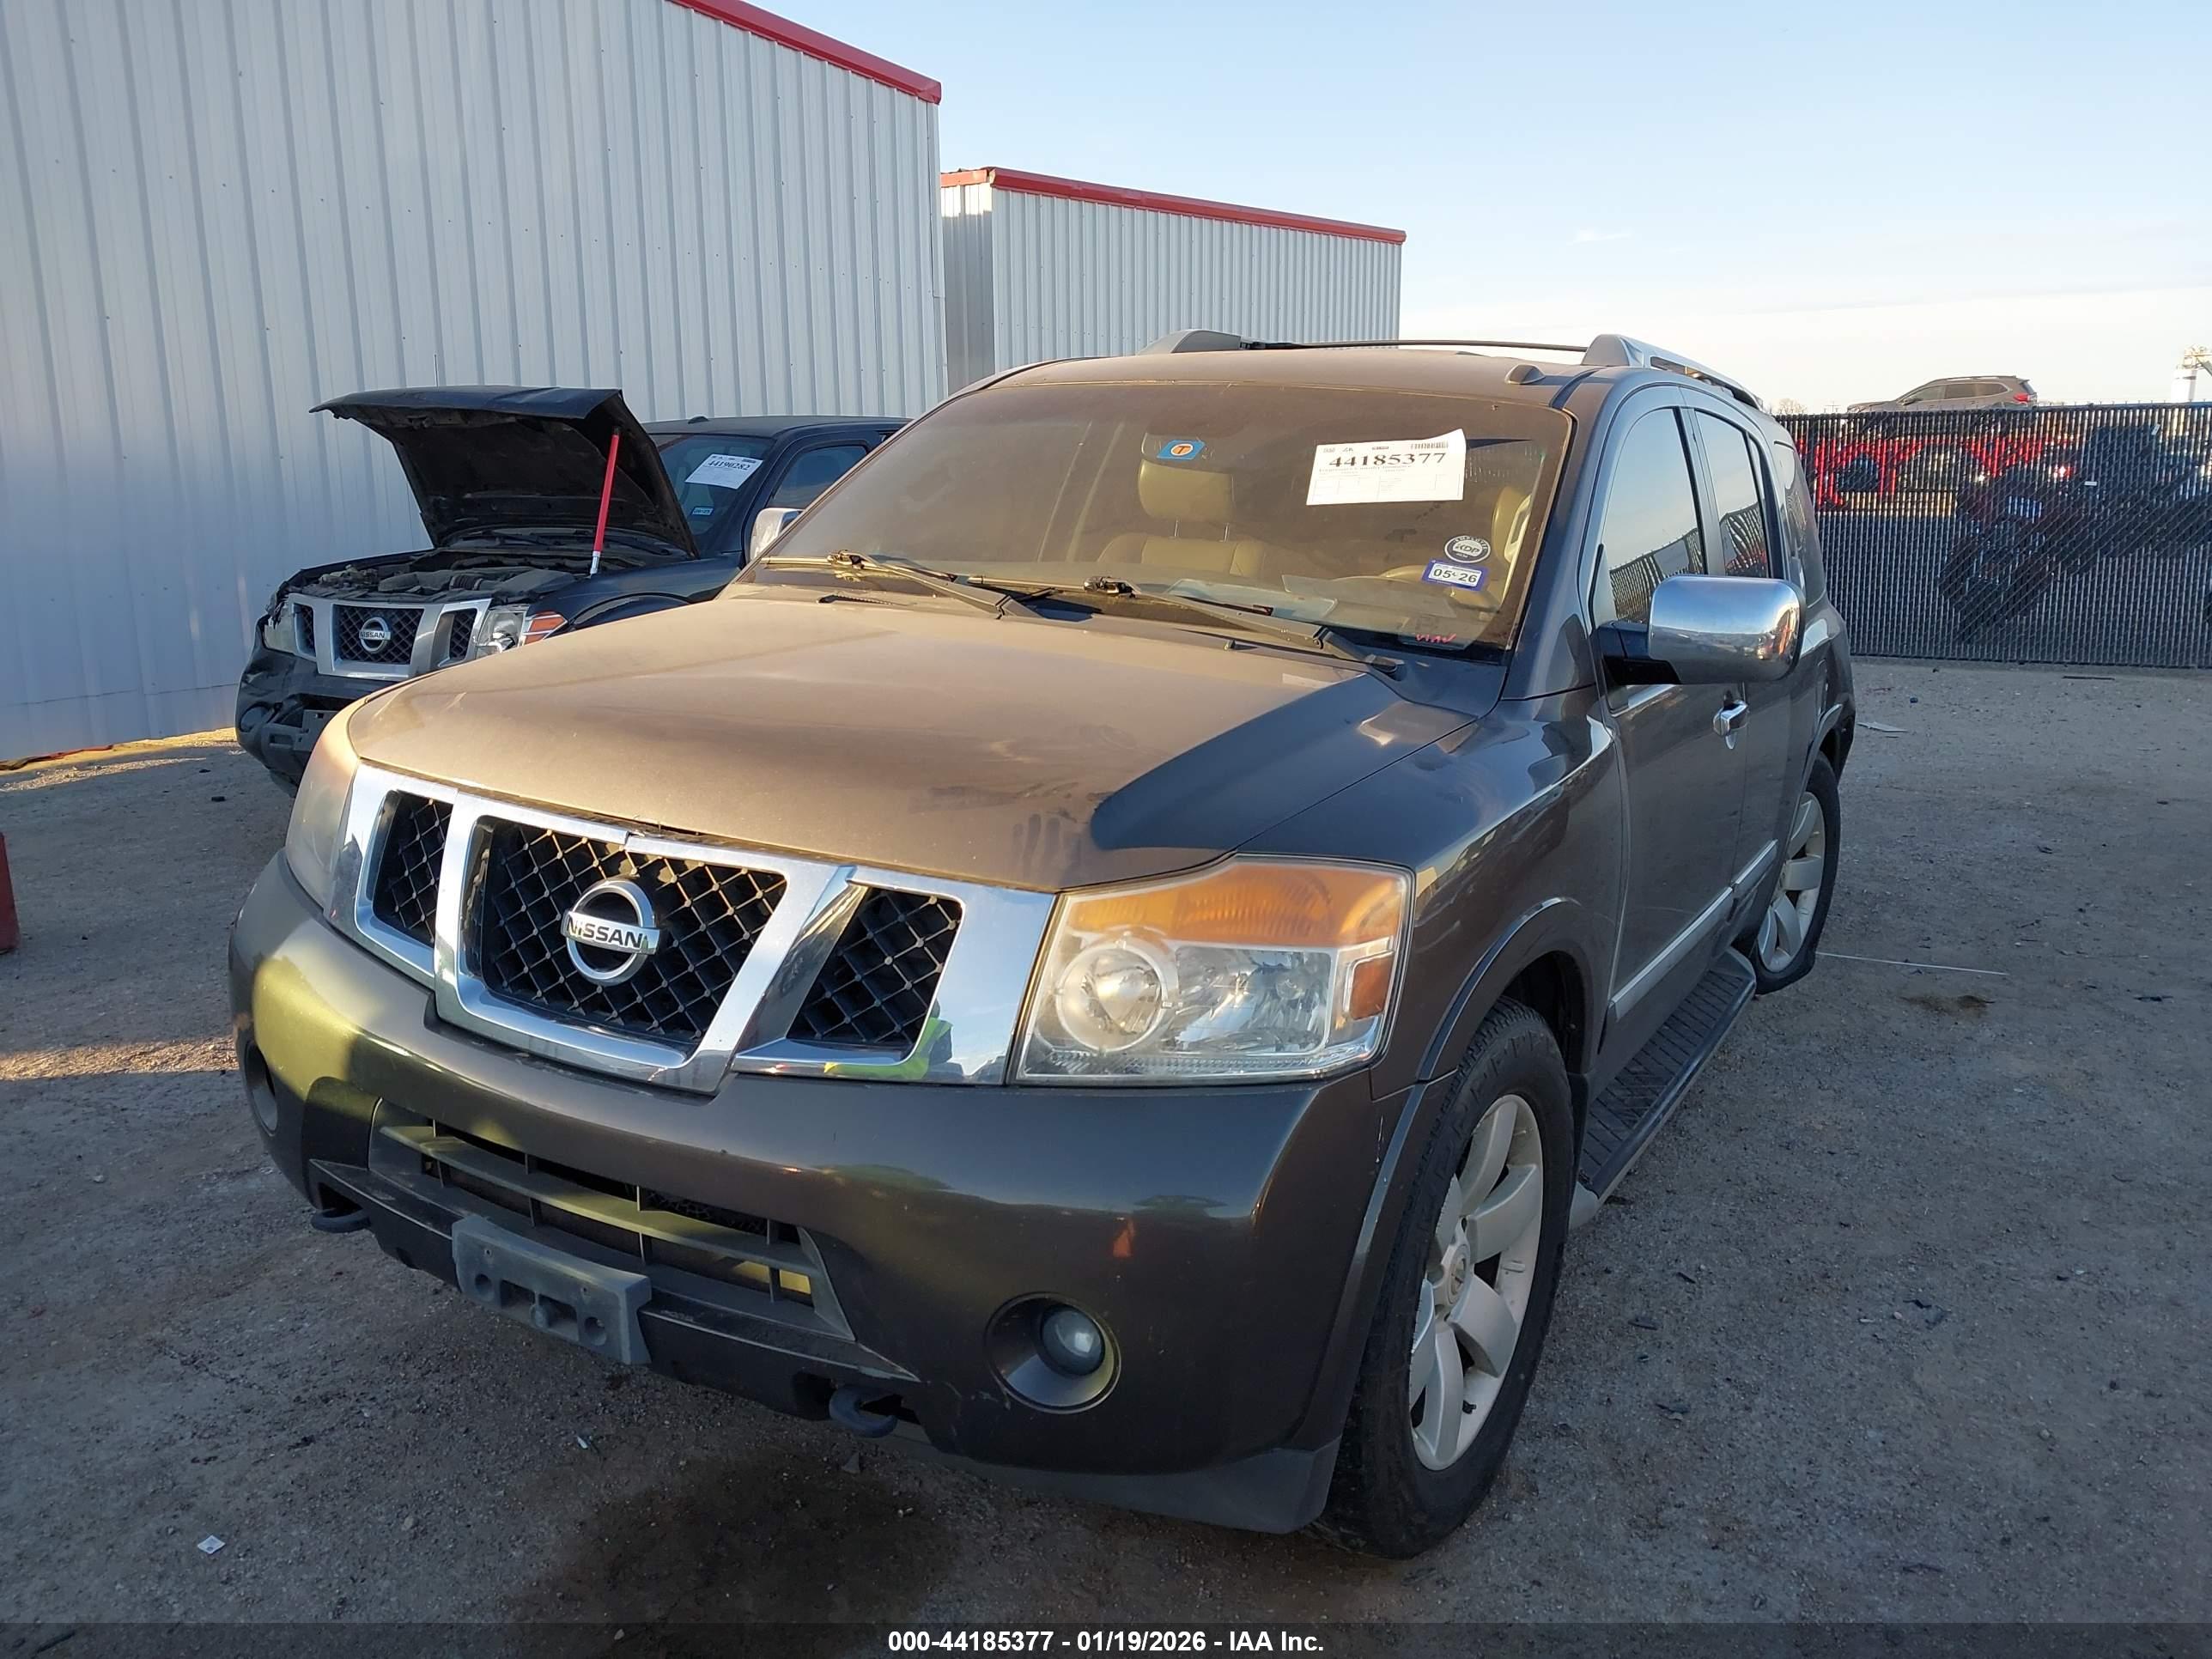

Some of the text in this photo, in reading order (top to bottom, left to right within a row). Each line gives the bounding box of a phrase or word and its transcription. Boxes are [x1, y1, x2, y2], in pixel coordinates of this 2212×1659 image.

[708, 459, 750, 471] 44190282
[1328, 453, 1446, 467] 44185377
[567, 915, 643, 948] NISSAN
